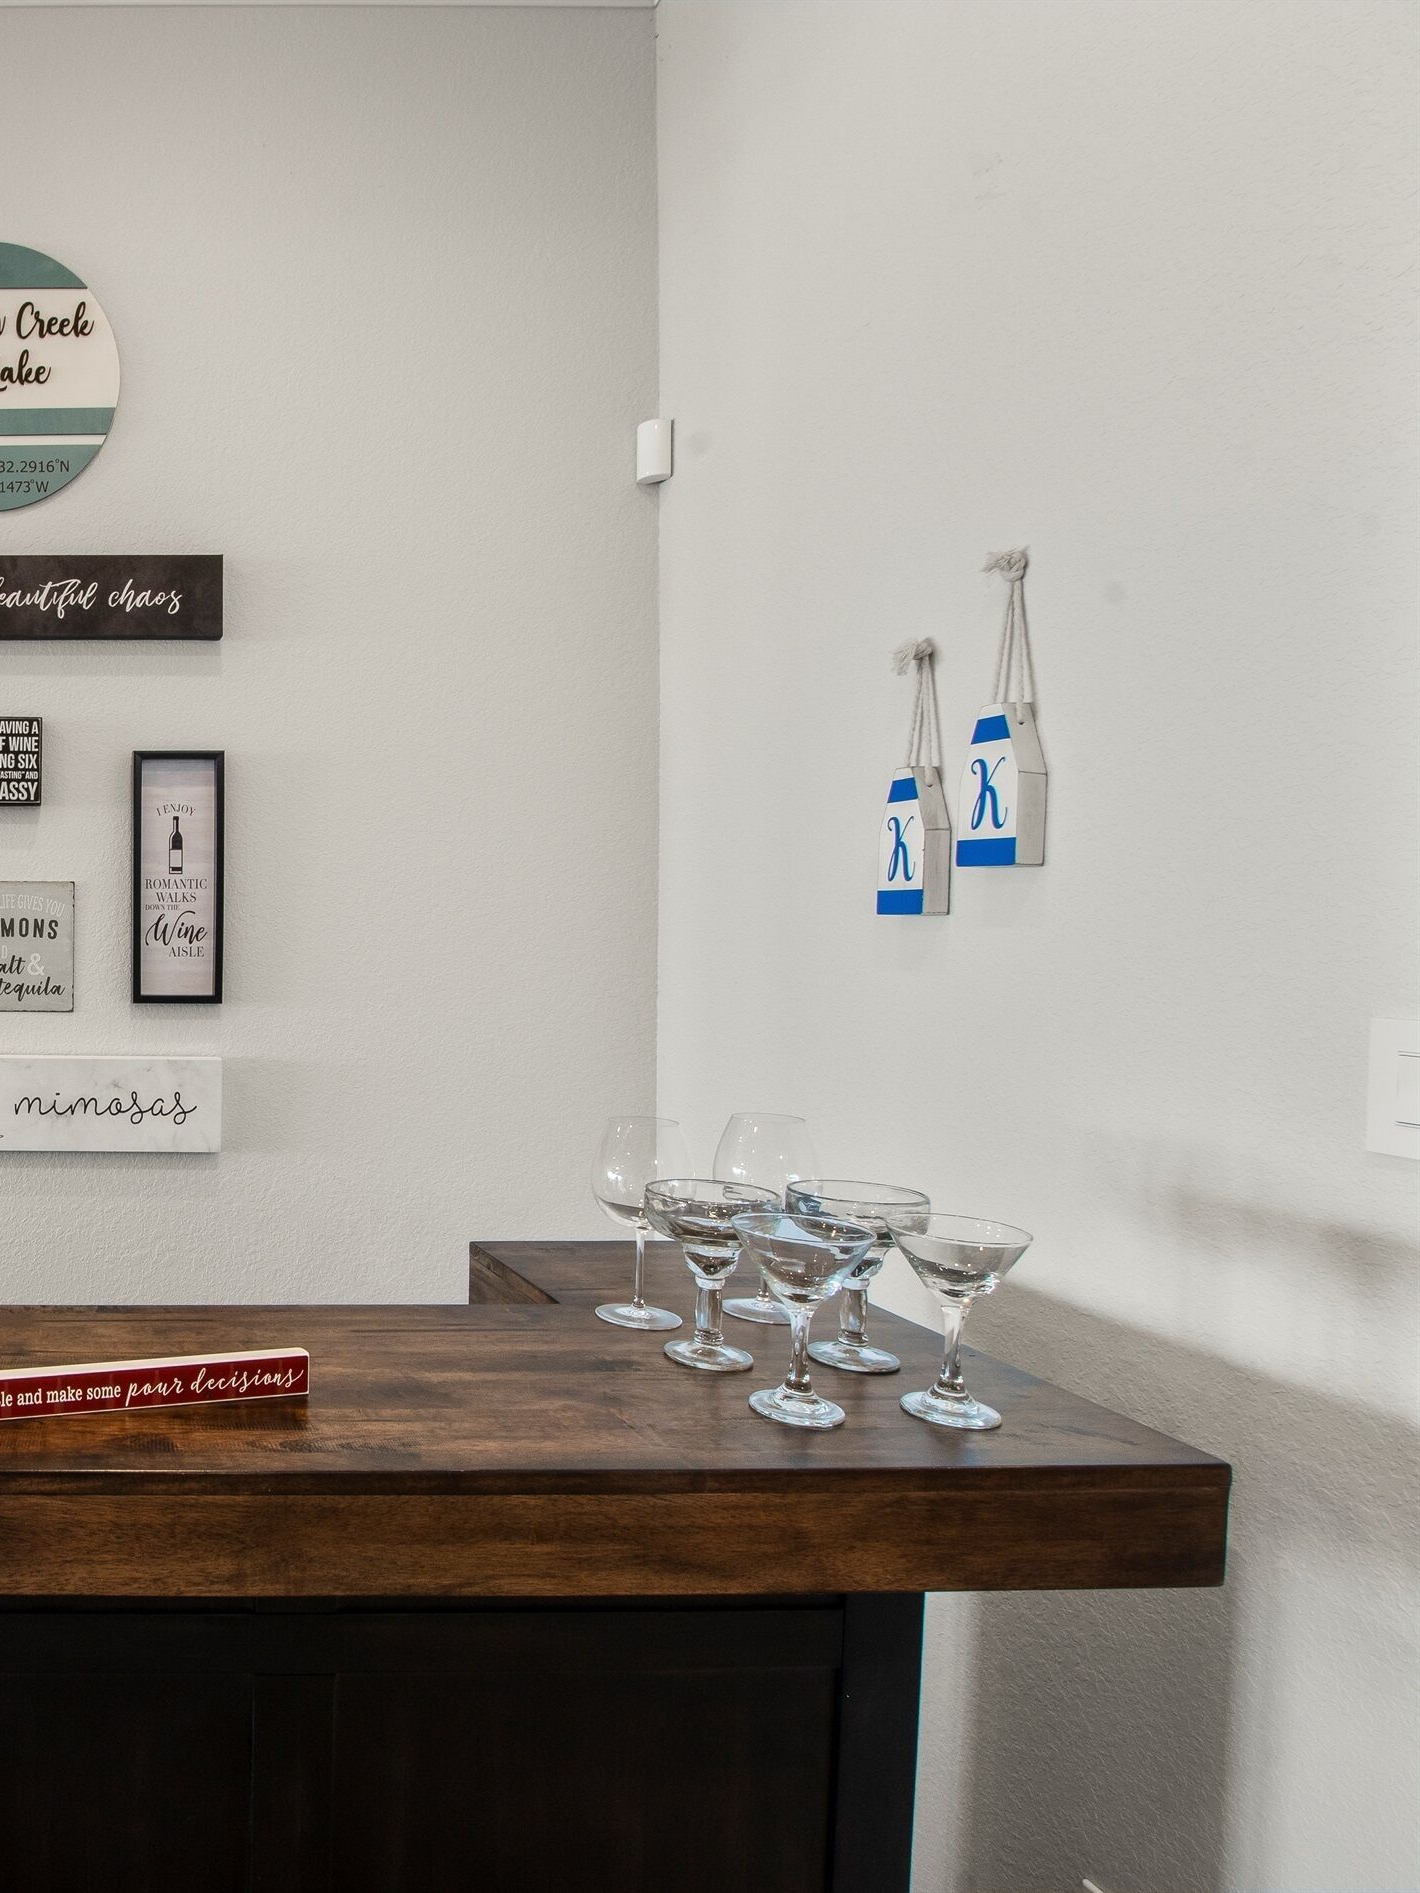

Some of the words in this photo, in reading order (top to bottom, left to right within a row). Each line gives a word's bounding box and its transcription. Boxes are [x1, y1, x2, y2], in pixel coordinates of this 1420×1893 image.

[16, 301, 95, 339] Creek
[108, 578, 182, 614] chaos
[31, 721, 39, 734] A
[8, 736, 39, 751] WINE
[17, 754, 37, 769] SIX
[25, 771, 38, 779] AND
[970, 756, 1008, 830] K
[157, 808, 161, 816] I
[163, 803, 196, 816] ENJOY
[887, 816, 916, 882] K
[145, 878, 208, 889] ROMANTIC
[17, 894, 43, 912] GIVES
[45, 898, 66, 917] YOU
[156, 892, 197, 902] WALKS
[145, 910, 208, 946] Wine
[169, 946, 205, 957] AISLE
[27, 953, 45, 976] &
[14, 1091, 197, 1125] mimosas
[17, 1388, 42, 1406] and
[46, 1386, 83, 1404] make
[86, 1384, 121, 1400] some
[125, 1377, 184, 1407] pour
[190, 1367, 304, 1393] decisions
